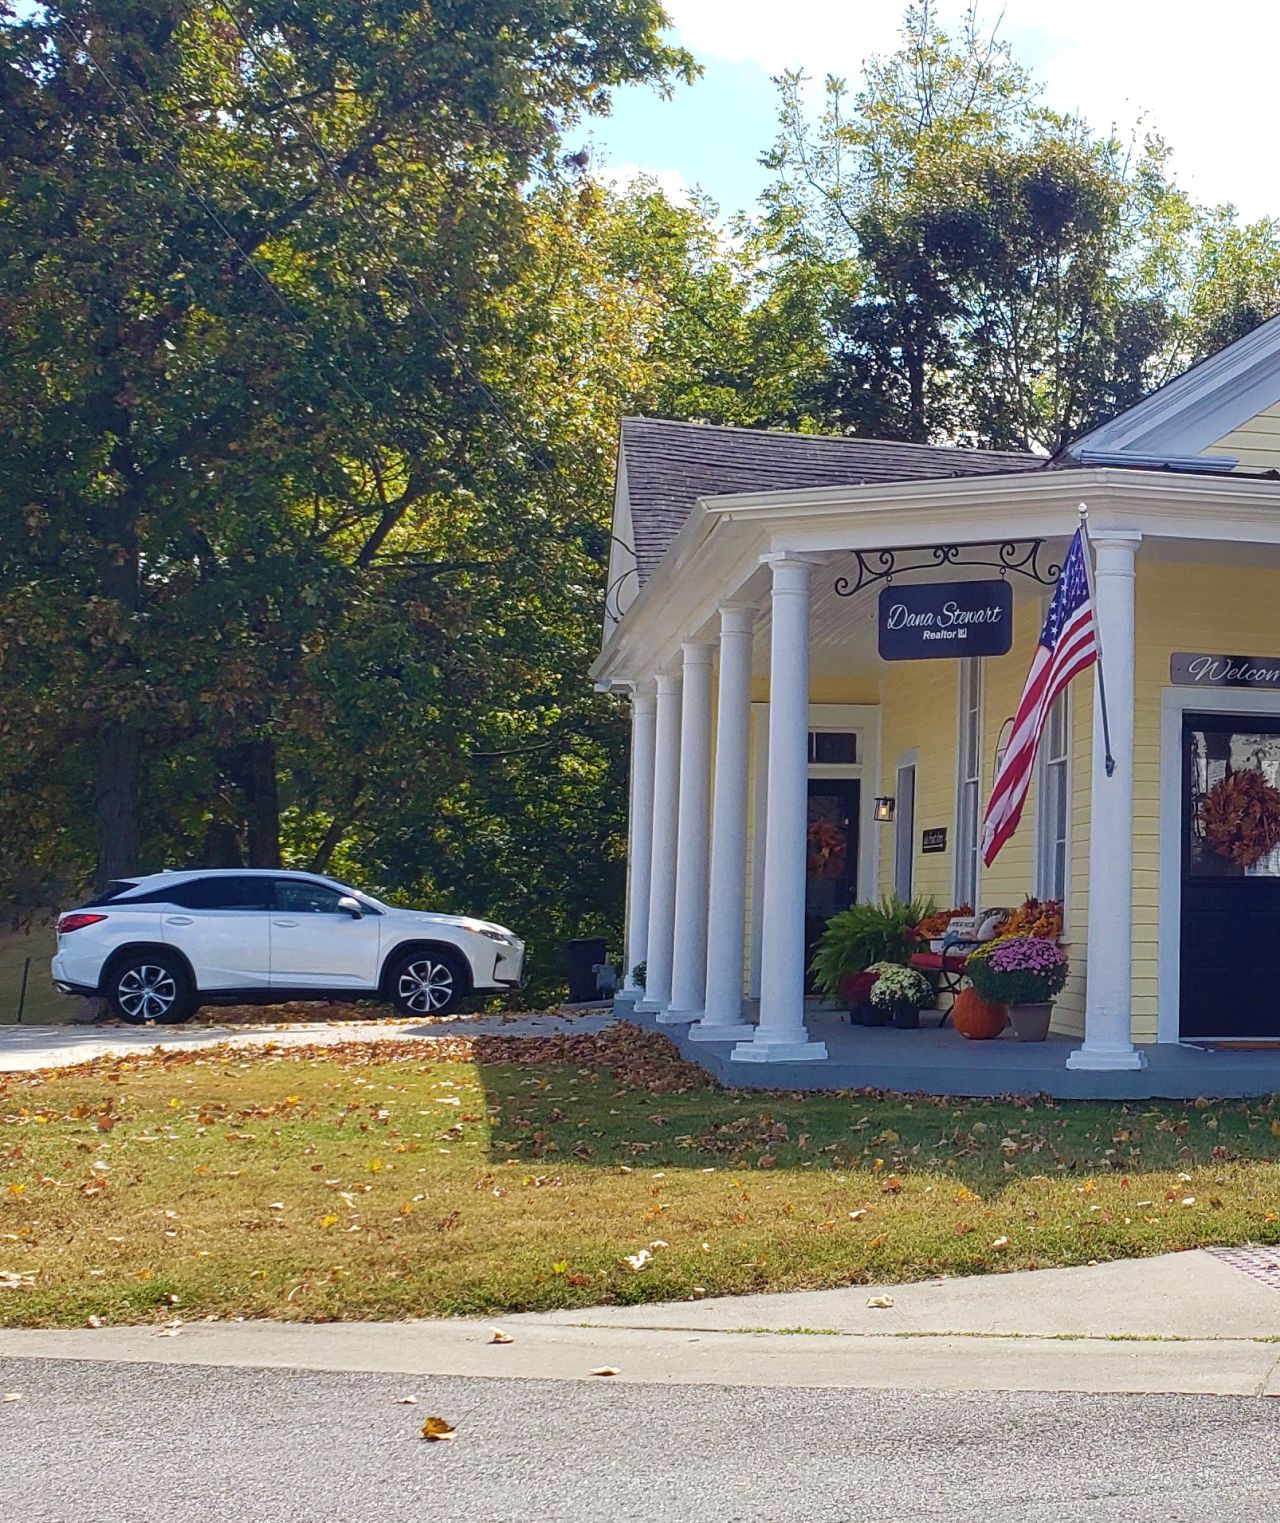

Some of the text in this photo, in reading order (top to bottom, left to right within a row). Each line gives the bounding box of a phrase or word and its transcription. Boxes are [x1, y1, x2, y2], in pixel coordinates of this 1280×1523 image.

[887, 601, 1003, 630] Dana Stewart
[922, 630, 957, 640] Realtor
